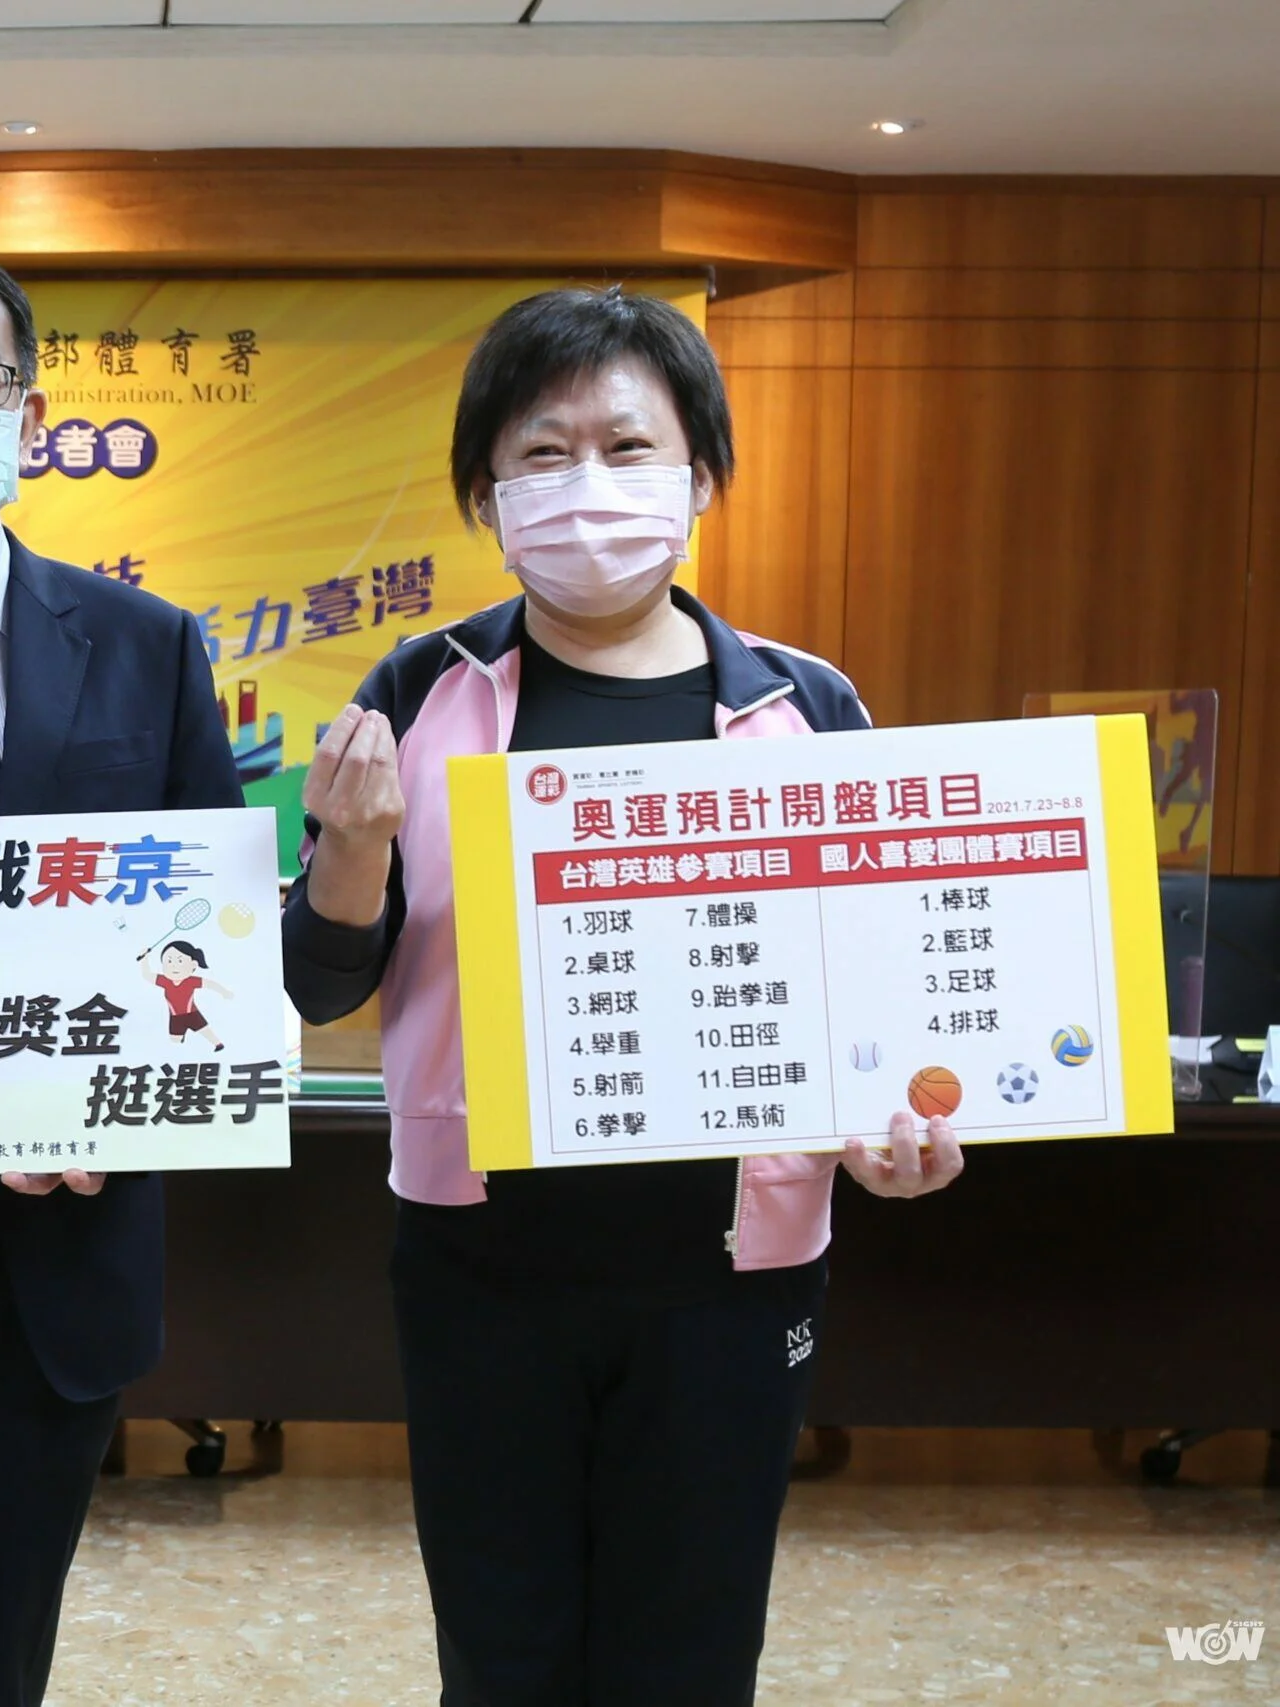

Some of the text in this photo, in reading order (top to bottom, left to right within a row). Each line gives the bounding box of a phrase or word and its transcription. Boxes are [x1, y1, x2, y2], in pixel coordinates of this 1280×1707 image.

[38, 327, 261, 377] 部體育署
[192, 383, 257, 404] MOE
[572, 773, 1084, 843] 奧運預計開盤項目 2021.7.23~8.8
[820, 829, 1082, 873] 國人喜愛團體賽項目
[560, 848, 791, 889] 台灣英雄參賽項目
[920, 886, 992, 912] 1.棒球
[562, 909, 634, 935] 1.羽球
[685, 901, 758, 928] 7.體操
[922, 926, 994, 953] 2.籃球
[564, 950, 637, 975] 2.桌球
[688, 941, 761, 968] 8.射擊
[925, 967, 997, 993] 3.足球
[567, 990, 639, 1016] 3.網球
[691, 980, 789, 1009] 9.跆拳道
[695, 1021, 781, 1048] 10.田徑
[927, 1008, 1000, 1035] 4.排球
[569, 1030, 642, 1056] 4.舉重
[572, 1071, 644, 1098] 5.射箭
[697, 1061, 808, 1089] 11.自由車
[83, 1060, 285, 1128] 挺選手
[575, 1111, 647, 1138] 6.拳擊
[700, 1103, 786, 1130] 12.馬術
